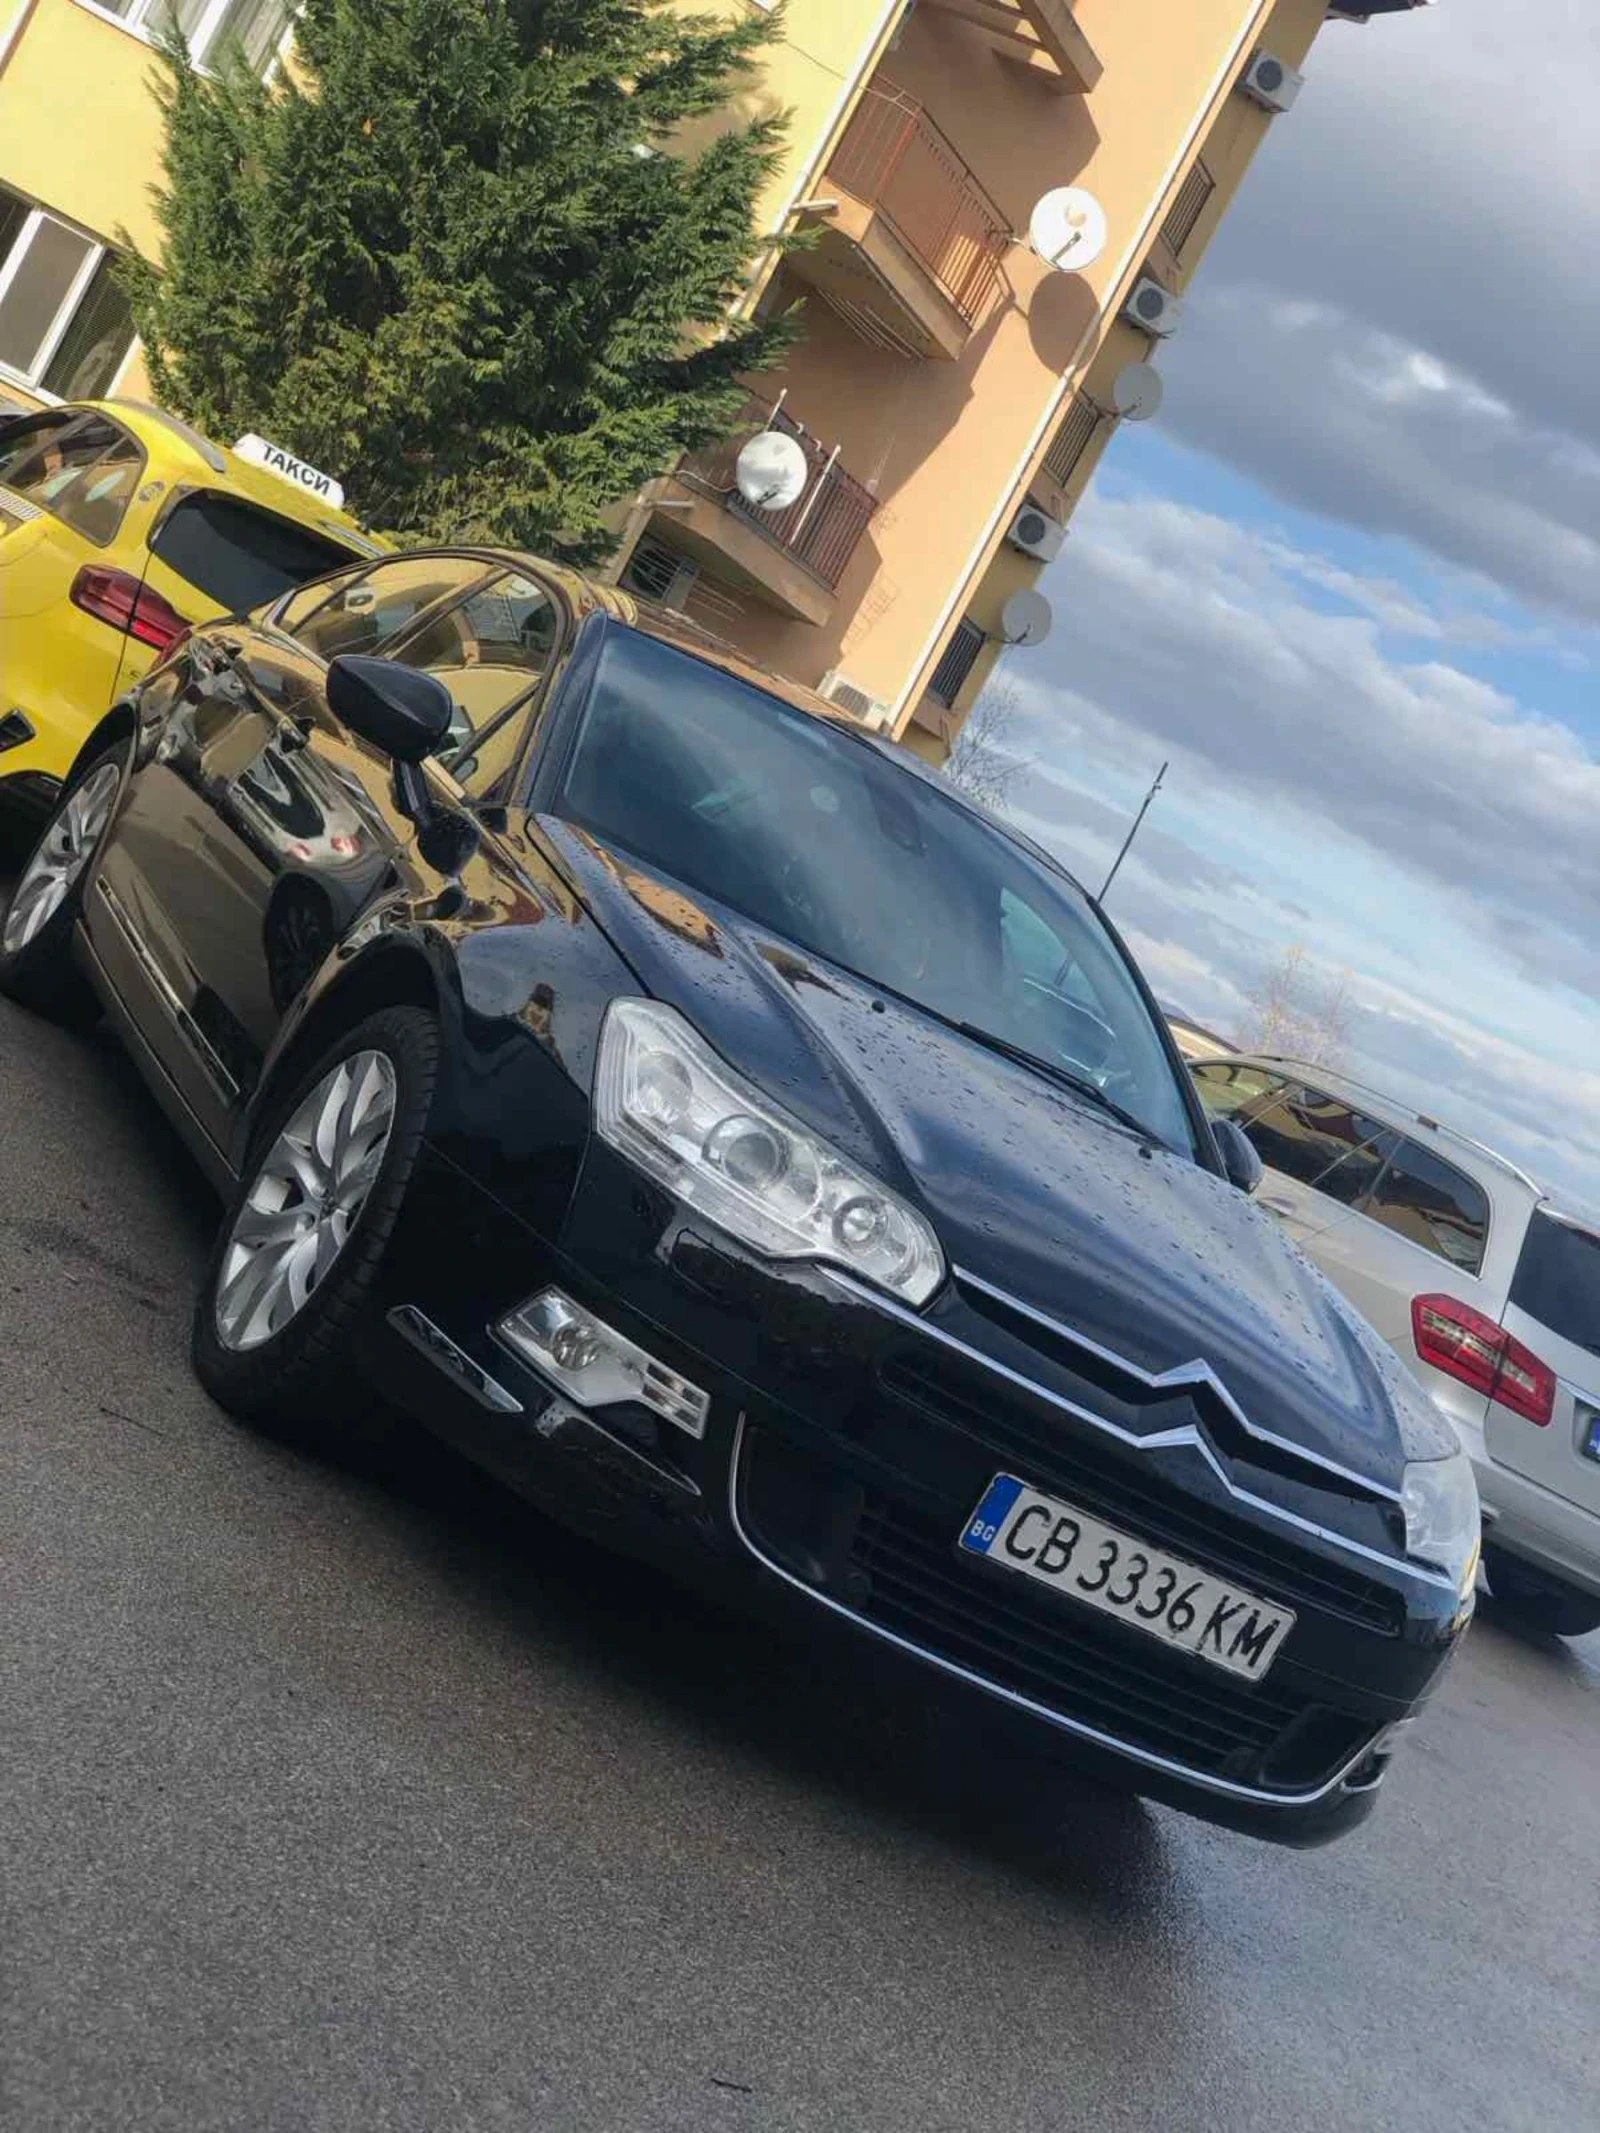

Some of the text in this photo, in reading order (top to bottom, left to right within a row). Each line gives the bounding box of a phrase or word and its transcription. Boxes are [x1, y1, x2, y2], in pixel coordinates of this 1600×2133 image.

[263, 443, 330, 496] ТАКСИ
[970, 1520, 996, 1542] BG
[1005, 1504, 1281, 1669] CB 3336 KM
